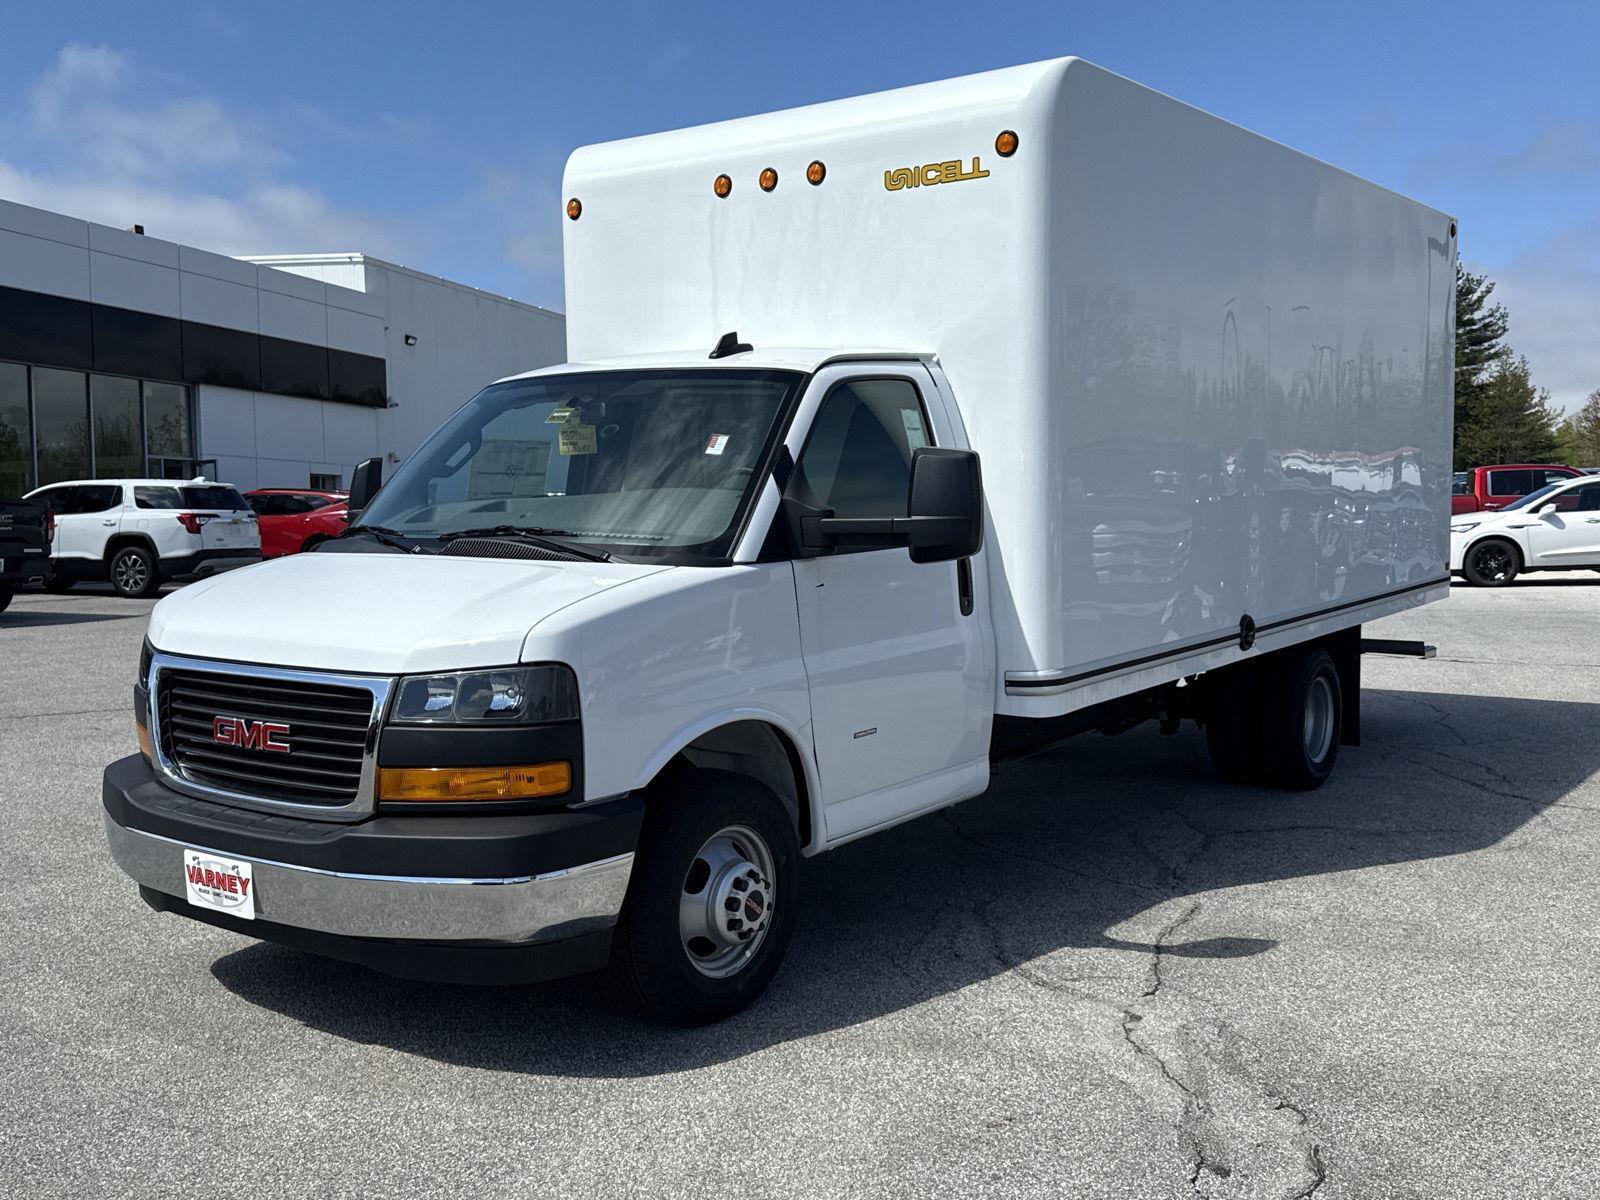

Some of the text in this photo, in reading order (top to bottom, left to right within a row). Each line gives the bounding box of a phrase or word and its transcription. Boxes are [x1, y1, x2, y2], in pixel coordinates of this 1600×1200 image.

[884, 157, 990, 191] UNICELL
[214, 716, 290, 753] GMC
[186, 864, 250, 895] VARNEY
